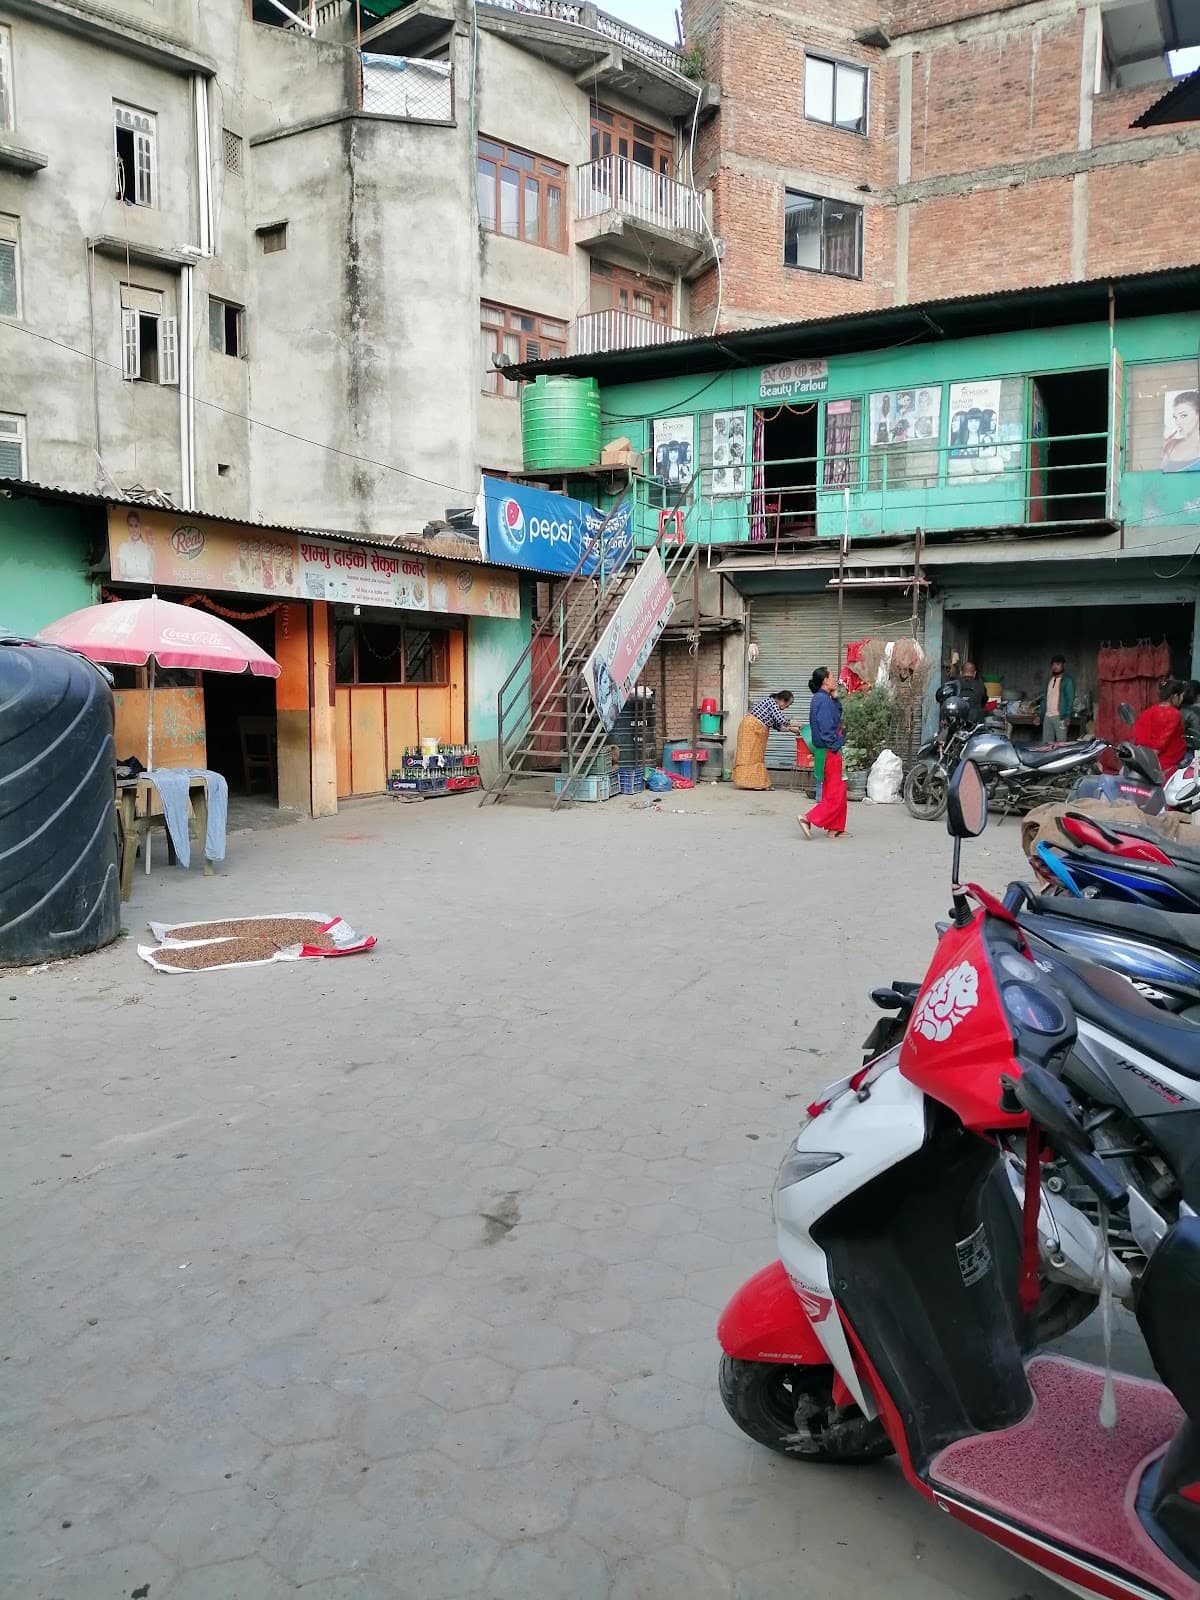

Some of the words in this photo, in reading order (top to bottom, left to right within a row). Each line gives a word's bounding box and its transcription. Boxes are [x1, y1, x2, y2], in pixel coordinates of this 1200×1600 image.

[763, 361, 824, 384] NOOR
[760, 383, 792, 397] Beauty
[794, 380, 828, 393] Parlour
[176, 529, 202, 555] Real
[529, 516, 572, 547] pepsi
[301, 543, 331, 569] शम्भु
[370, 549, 399, 578] सेकुवा
[630, 612, 653, 646] Training
[651, 582, 668, 609] Center
[1116, 1060, 1190, 1102] HORNET
